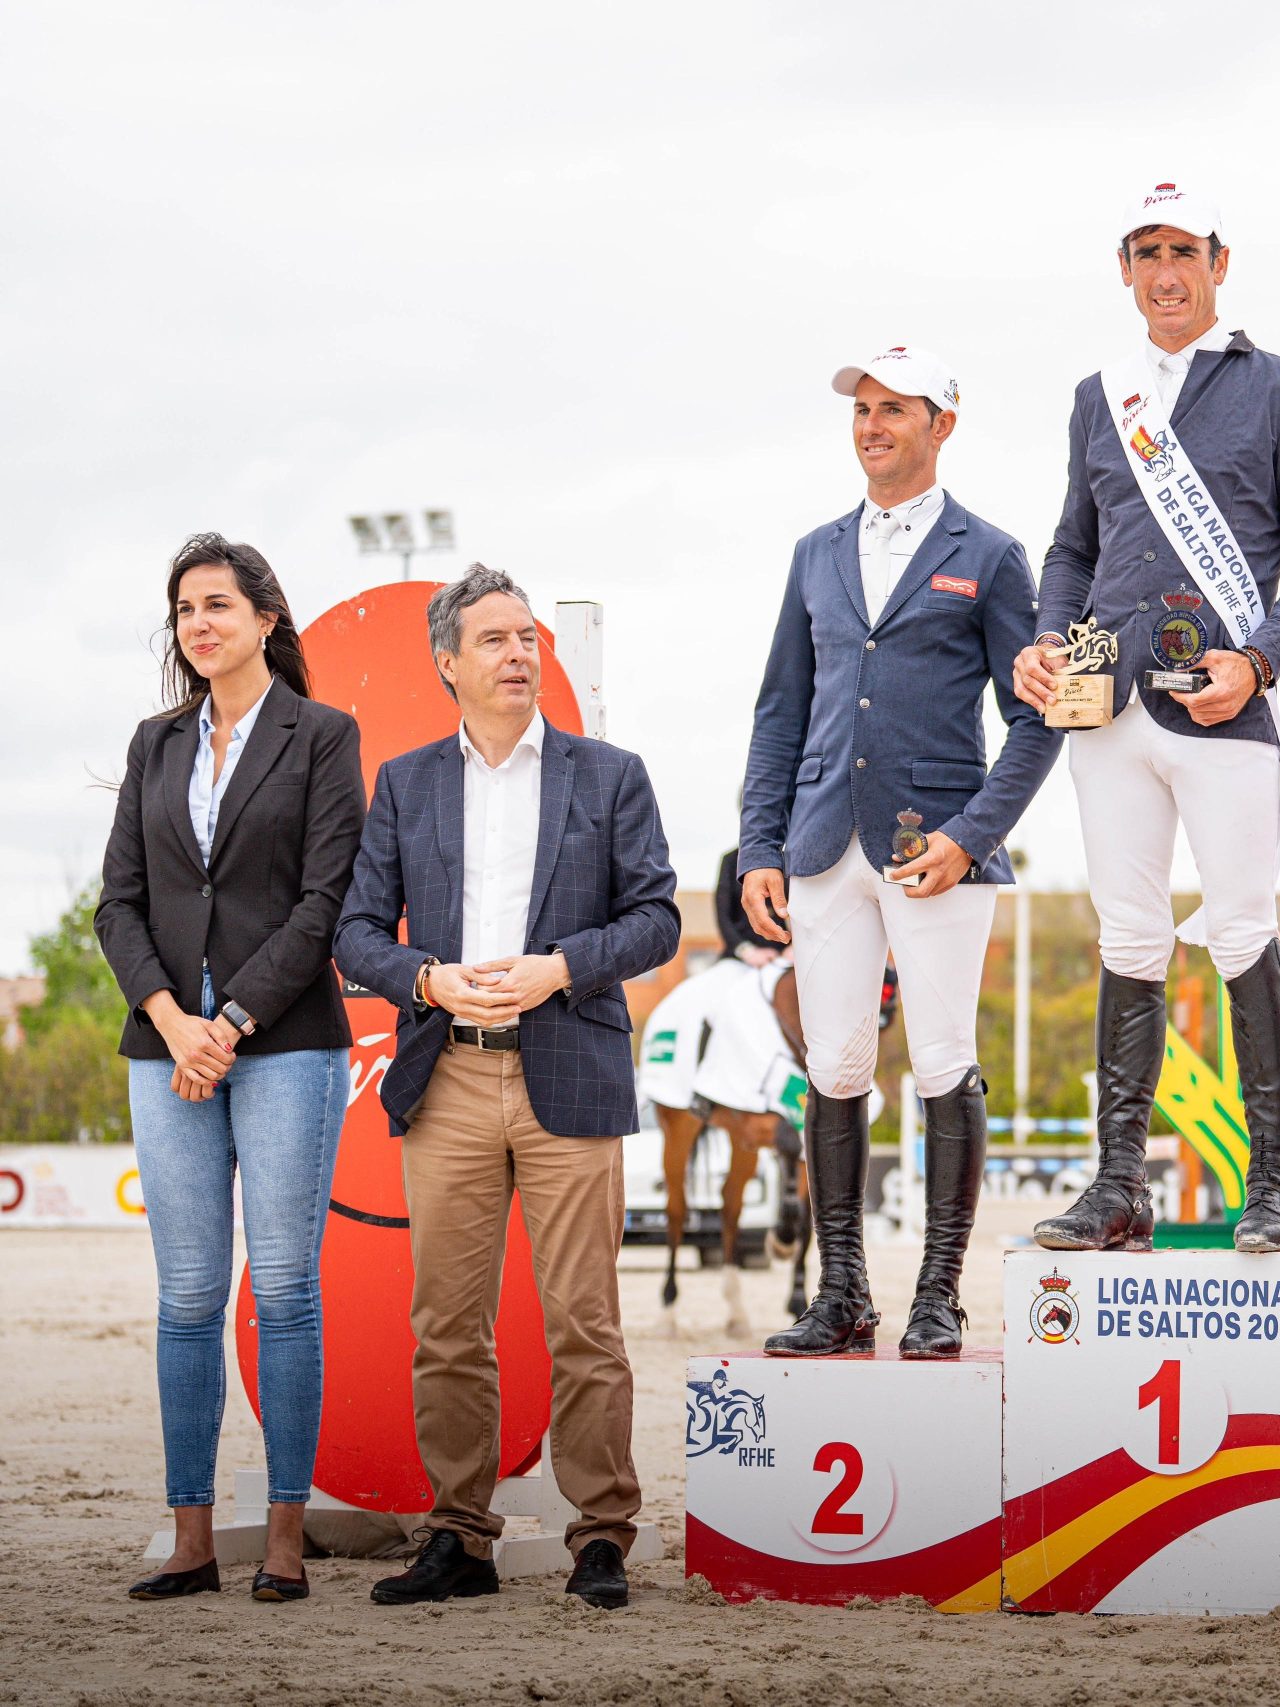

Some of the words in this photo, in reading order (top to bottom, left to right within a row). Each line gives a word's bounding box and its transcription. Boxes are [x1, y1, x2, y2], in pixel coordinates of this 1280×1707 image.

[1156, 487, 1180, 515] DE
[1171, 512, 1222, 581] SALTOS
[1215, 579, 1242, 612] RFHE
[1177, 473, 1211, 520] LIGA
[1203, 517, 1260, 615] NACIONAL
[1097, 1277, 1159, 1306] LIGA
[1097, 1309, 1132, 1337] DE
[1138, 1309, 1241, 1340] SALTOS
[739, 1447, 776, 1468] RFHE
[1138, 1359, 1180, 1465] 1
[811, 1441, 864, 1535] 2
